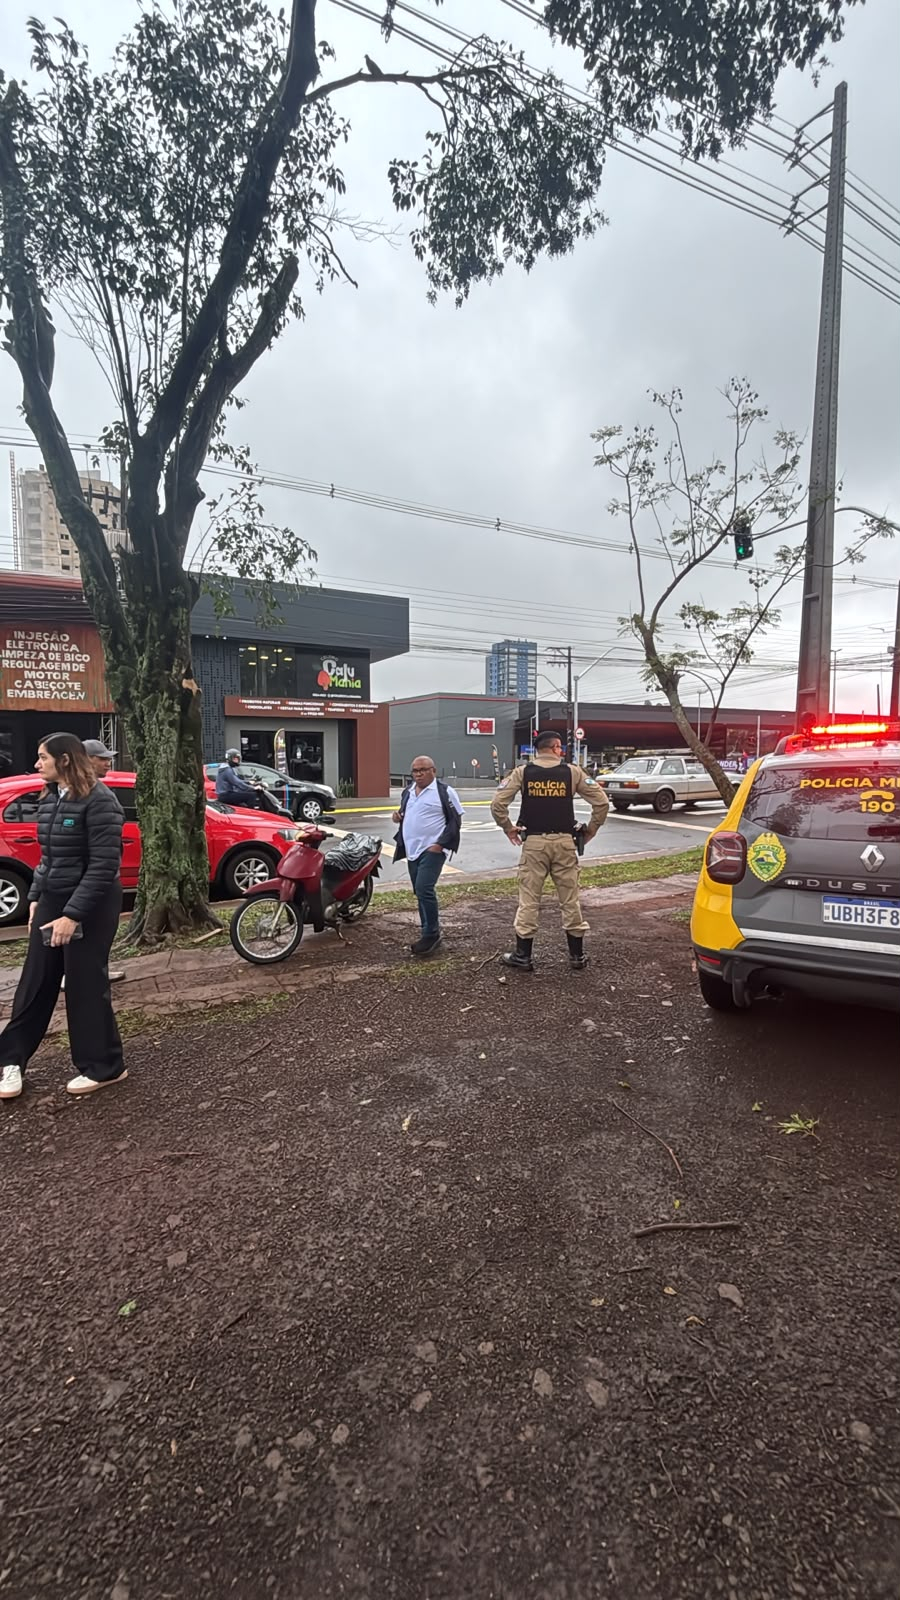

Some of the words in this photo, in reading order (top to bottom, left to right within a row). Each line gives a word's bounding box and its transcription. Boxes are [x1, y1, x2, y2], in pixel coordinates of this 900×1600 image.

[13, 630, 70, 642] INJEÇÃO
[0, 649, 46, 660] IMPEZA
[48, 652, 61, 661] DE
[64, 653, 91, 662] BICO
[2, 659, 71, 671] REGULAGEM
[72, 663, 86, 672] DE
[24, 670, 70, 680] MOTOR
[528, 780, 567, 789] POLÍCIA
[528, 789, 566, 797] MILITAR
[859, 800, 895, 813] 190
[831, 904, 900, 926] UBH3F8
